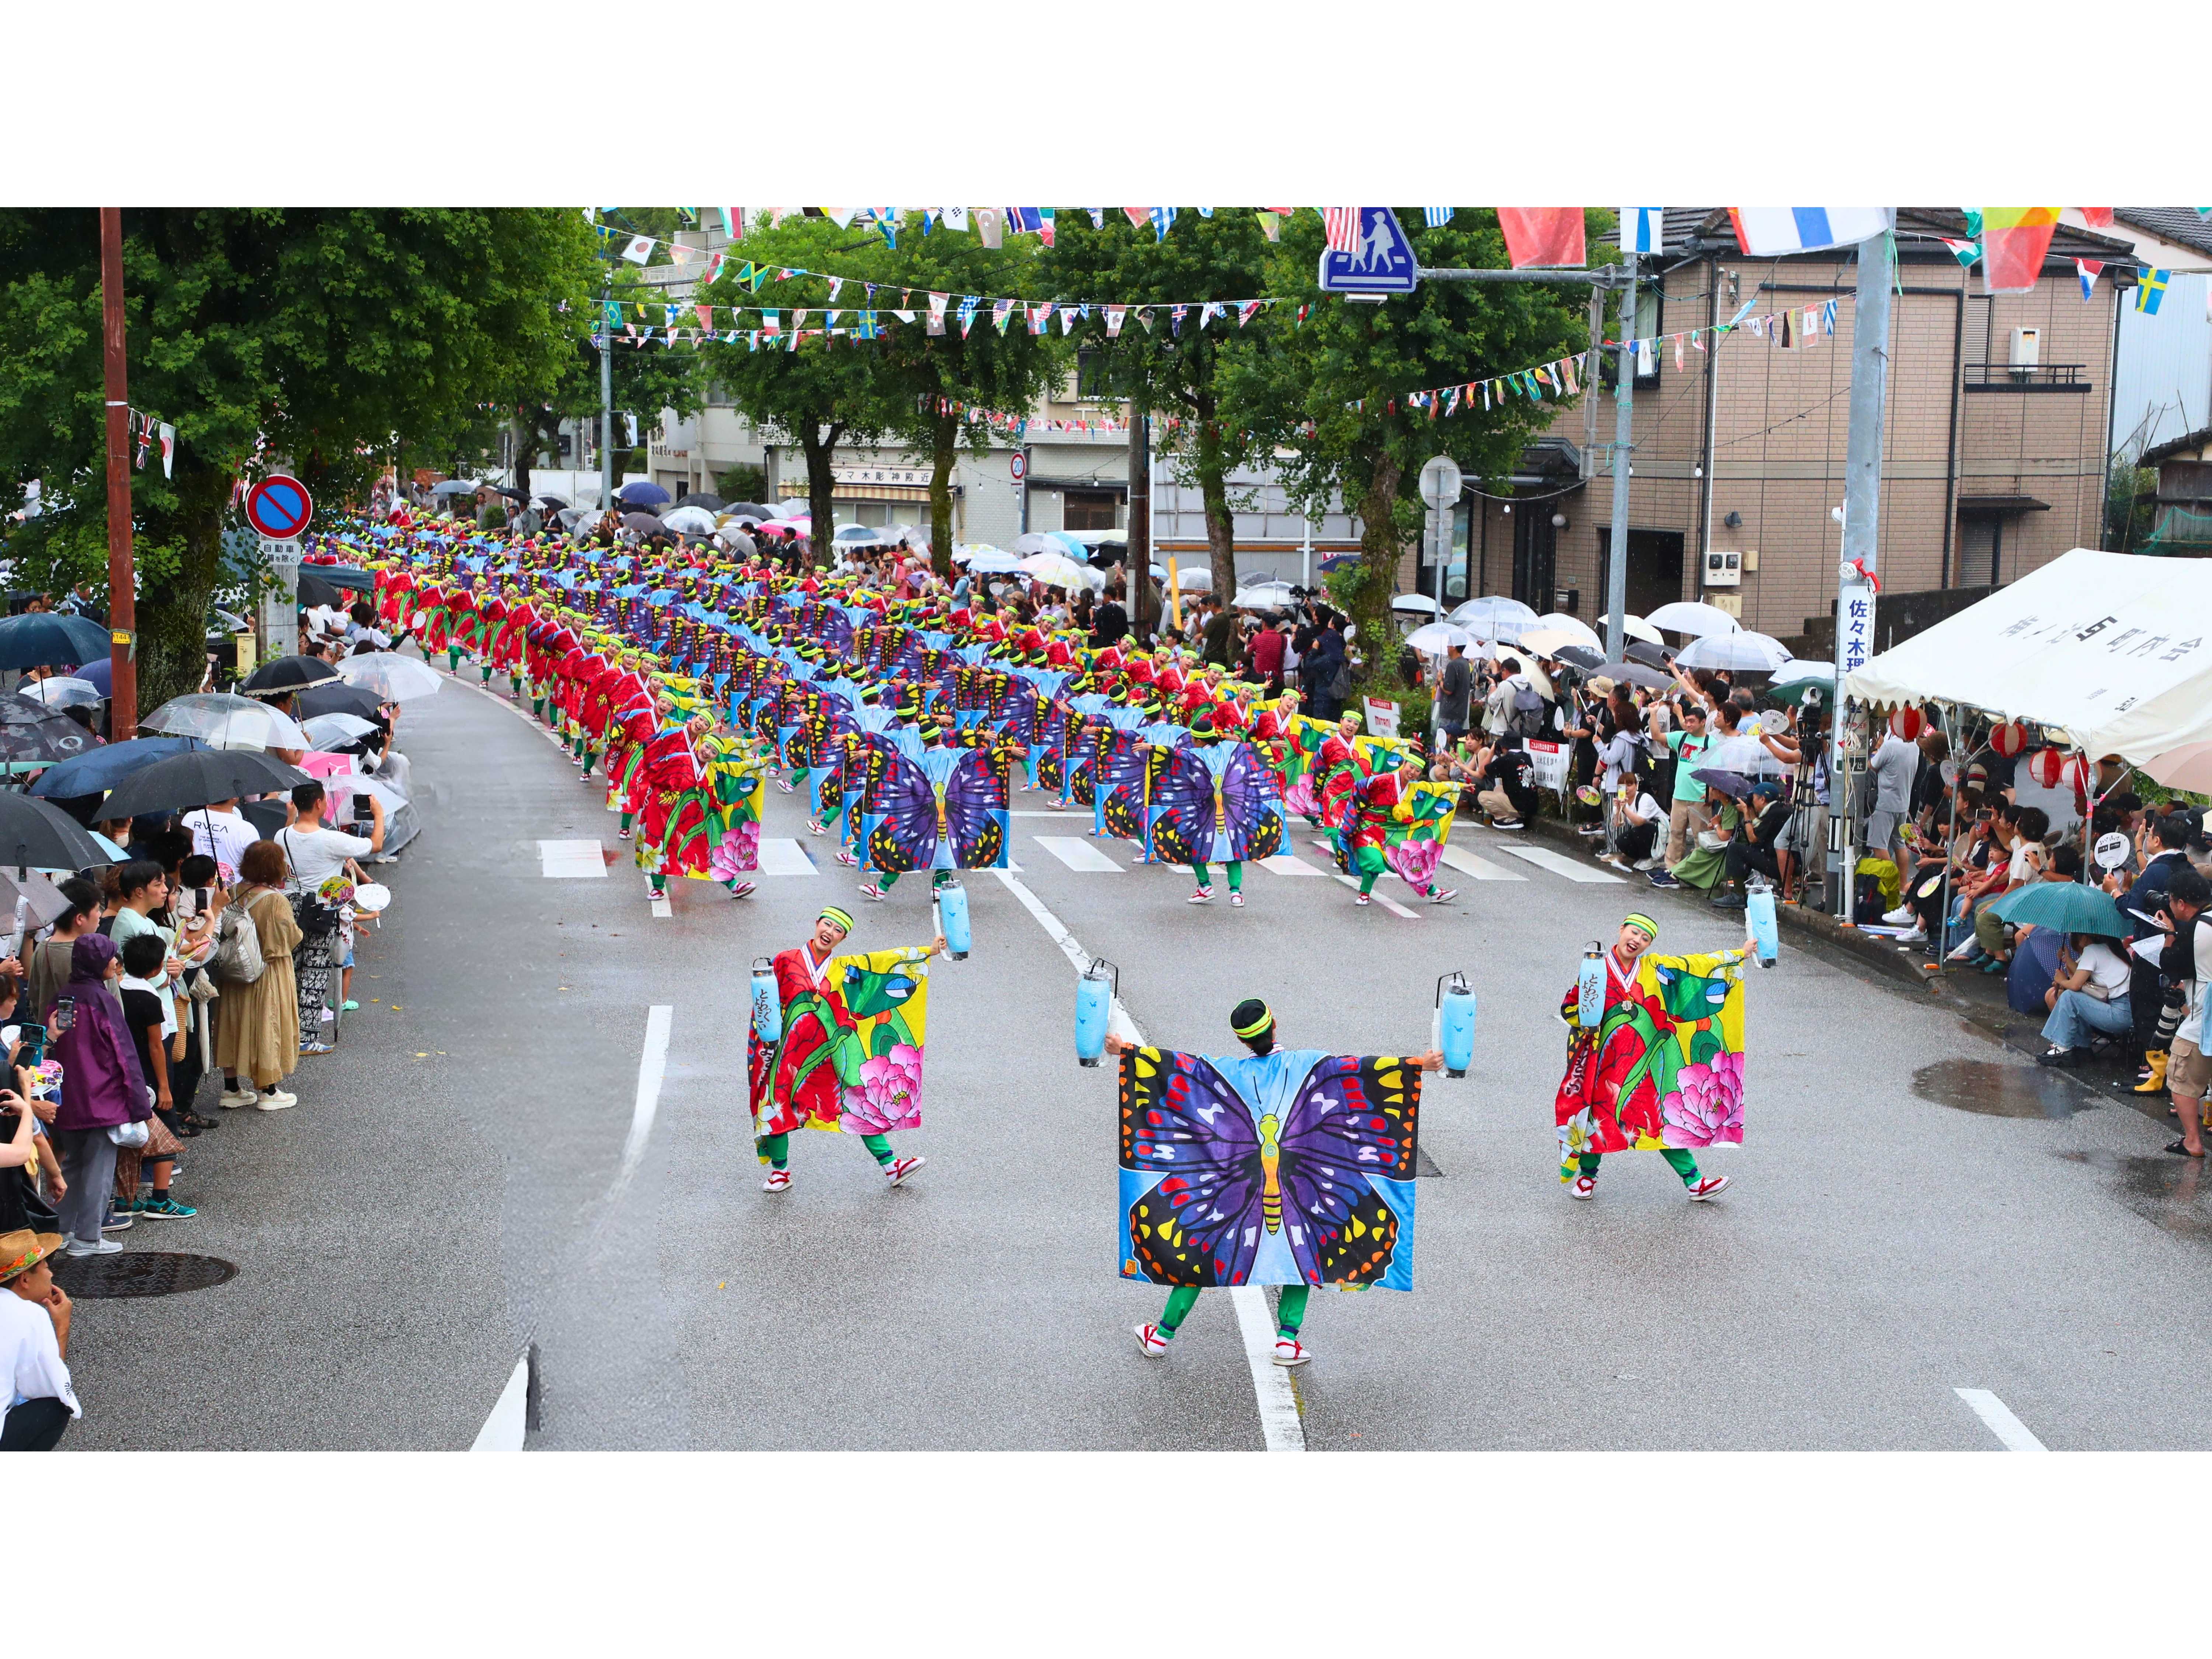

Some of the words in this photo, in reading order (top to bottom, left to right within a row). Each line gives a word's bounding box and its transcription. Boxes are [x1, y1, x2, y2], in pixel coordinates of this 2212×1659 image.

[1014, 461, 1022, 472] 20
[264, 544, 294, 553] 自動車
[263, 554, 299, 563] 輪を除く)
[1375, 715, 1391, 729] MITANI
[194, 821, 228, 833] RVCA
[1582, 980, 1590, 1014] よさこい
[1589, 973, 1599, 1008] とらっく
[760, 988, 772, 1022] とらっく
[755, 997, 766, 1031] よさこい
